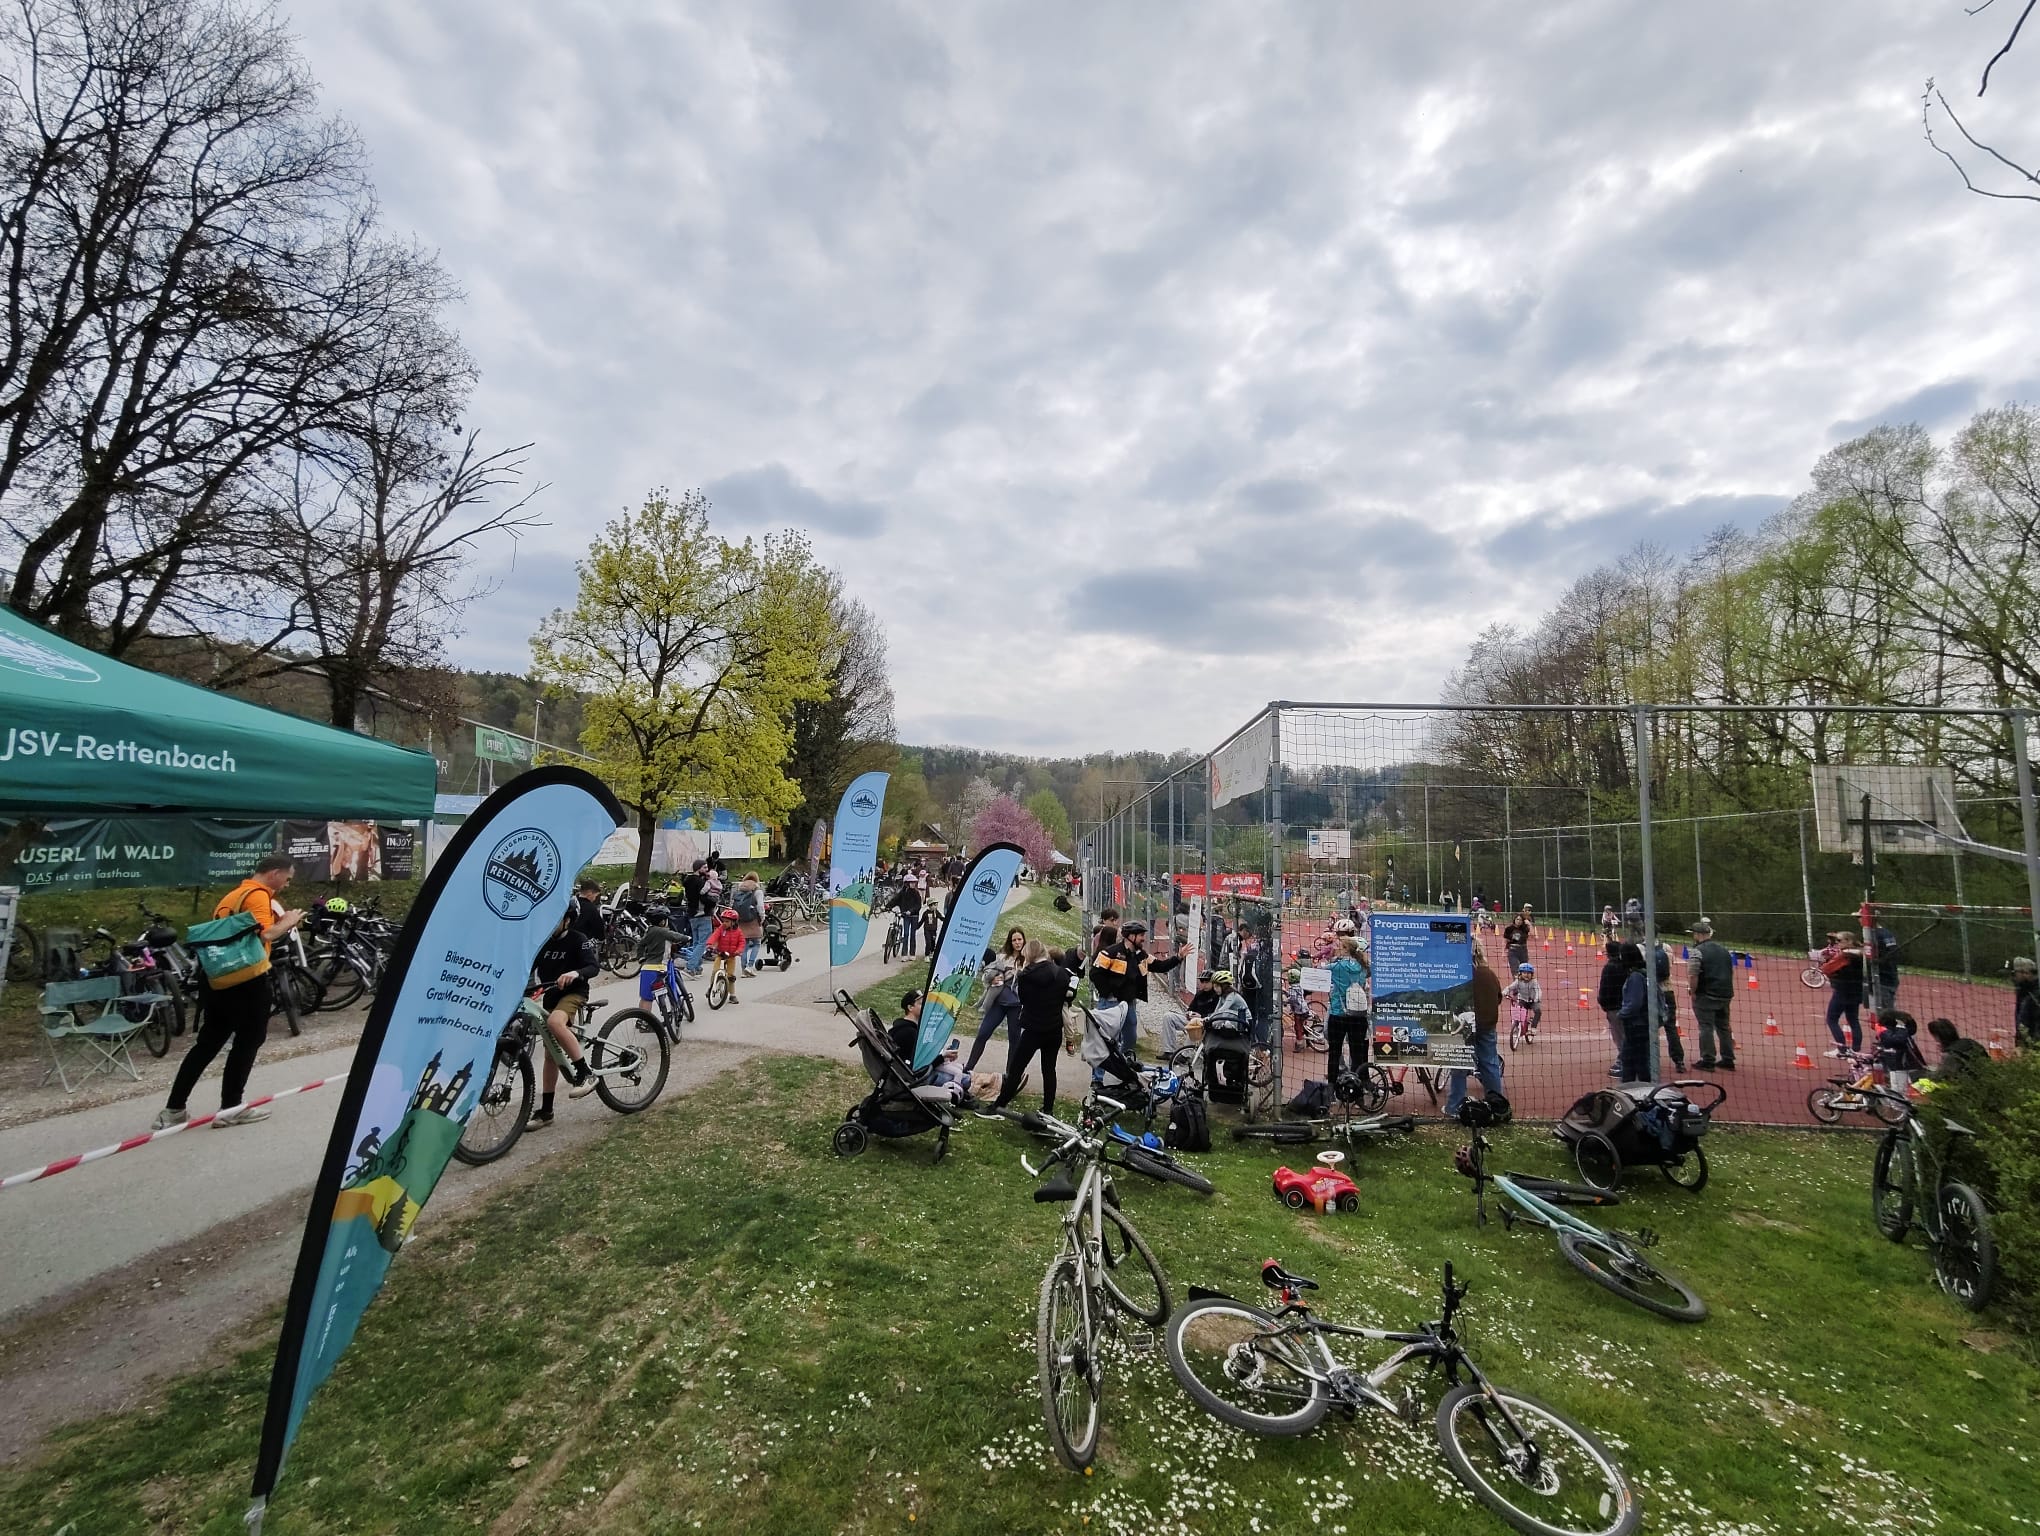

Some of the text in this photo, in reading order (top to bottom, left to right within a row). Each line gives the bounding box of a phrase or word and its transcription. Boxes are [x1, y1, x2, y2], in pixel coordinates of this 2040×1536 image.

[0, 728, 236, 772] JSV-Rettenbach
[14, 845, 175, 864] USERL IM WALD
[26, 872, 52, 884] DAS
[56, 872, 70, 881] ist
[73, 871, 92, 880] ein
[1374, 919, 1430, 930] Programm
[544, 950, 566, 960] FOX
